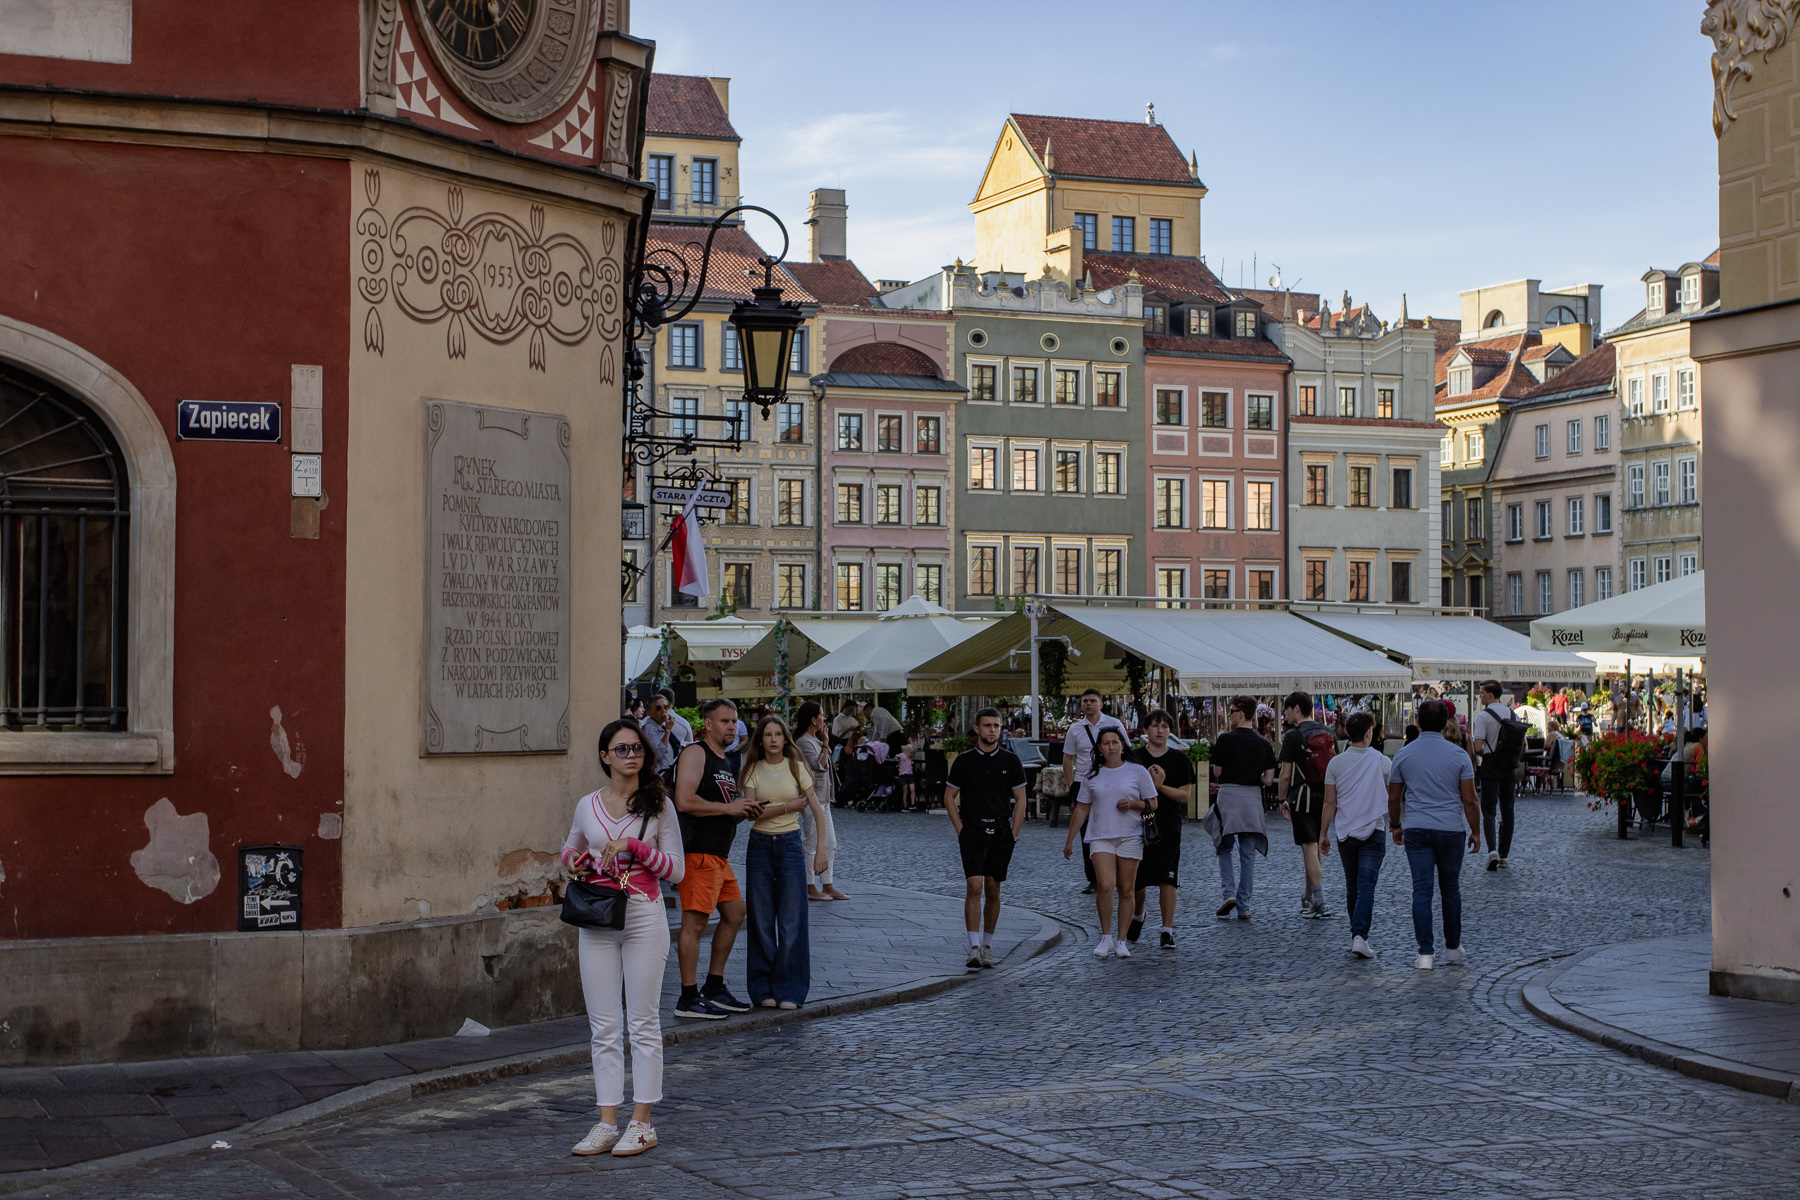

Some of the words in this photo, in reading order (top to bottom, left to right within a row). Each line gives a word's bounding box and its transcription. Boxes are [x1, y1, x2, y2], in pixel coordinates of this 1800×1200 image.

[483, 261, 513, 290] 1953
[188, 404, 270, 434] Zapiecek
[632, 414, 643, 434] PUB
[295, 460, 302, 472] Z
[454, 455, 497, 489] RYNEK
[476, 477, 523, 496] STAREGO
[524, 480, 562, 502] MIASTA
[656, 491, 686, 500] STARA
[442, 494, 482, 514] POMNIK
[500, 516, 559, 537] NARODOWEJ
[446, 534, 474, 552] WALK
[486, 555, 558, 574] WARSZAWY
[442, 572, 489, 590] ZWALONY
[490, 574, 500, 592] W
[532, 576, 559, 594] PRZEZ
[466, 611, 477, 628] W
[481, 611, 501, 628] 1944
[476, 630, 511, 646] POLSKI
[1552, 629, 1584, 646] Kozel
[1680, 629, 1706, 647] Koz
[442, 646, 448, 662] Z
[447, 665, 498, 681] NARODOWI
[1518, 669, 1554, 678] RESTAURACJA
[455, 682, 465, 698] W
[467, 682, 503, 698] LATACH
[505, 682, 546, 700] 1951-1953
[822, 676, 854, 690] OKOCIM
[1314, 681, 1358, 690] RESTAURACJA
[1360, 681, 1379, 689] STARA
[1380, 680, 1405, 689] POCZTA
